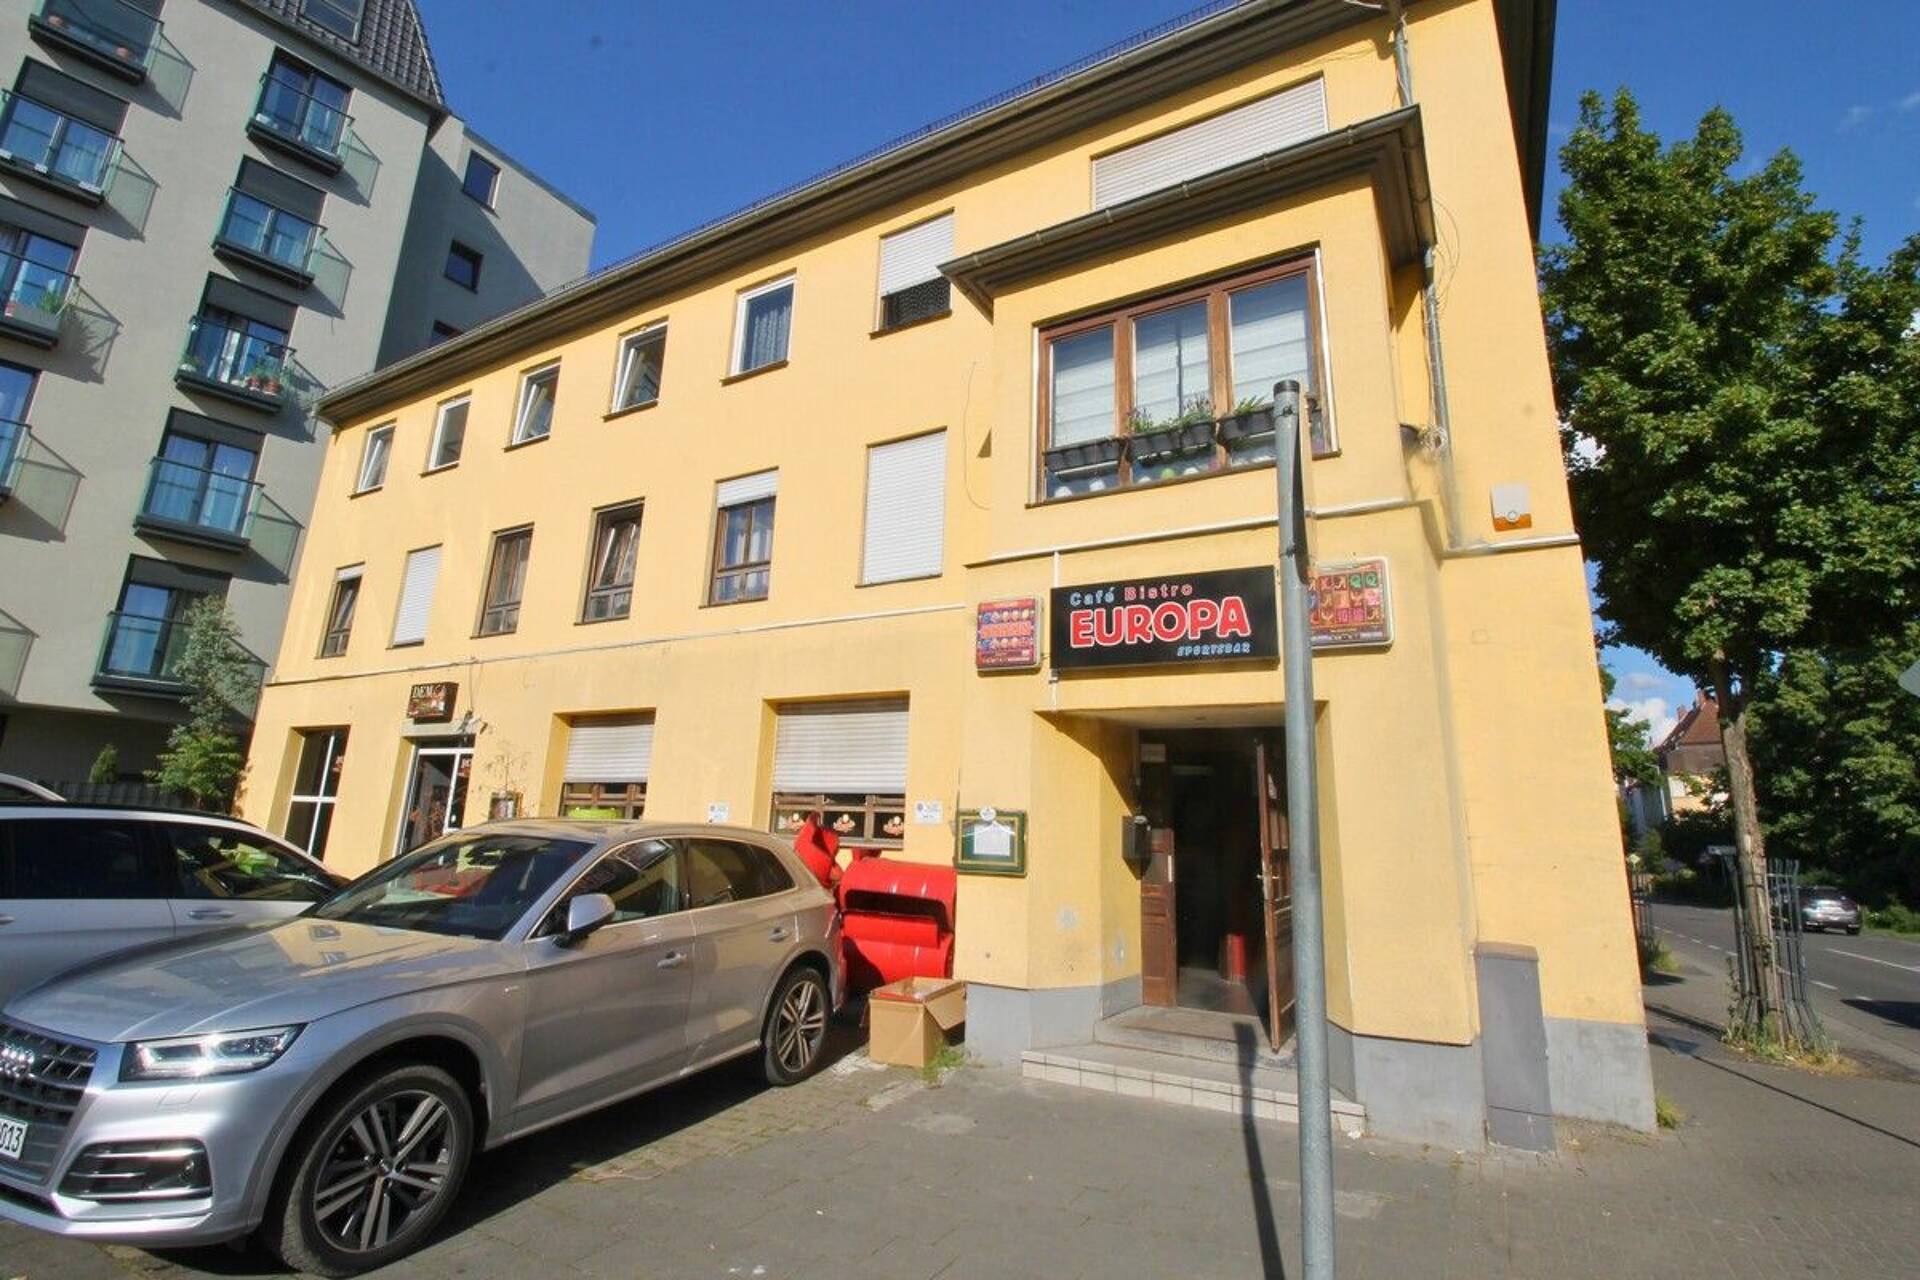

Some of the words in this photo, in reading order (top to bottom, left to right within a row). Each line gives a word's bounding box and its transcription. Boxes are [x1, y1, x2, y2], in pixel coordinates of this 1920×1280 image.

[1069, 586, 1116, 607] Café
[1124, 583, 1193, 601] Bistro
[1070, 596, 1252, 648] EUROPA
[1177, 642, 1251, 657] SPORTSBAR
